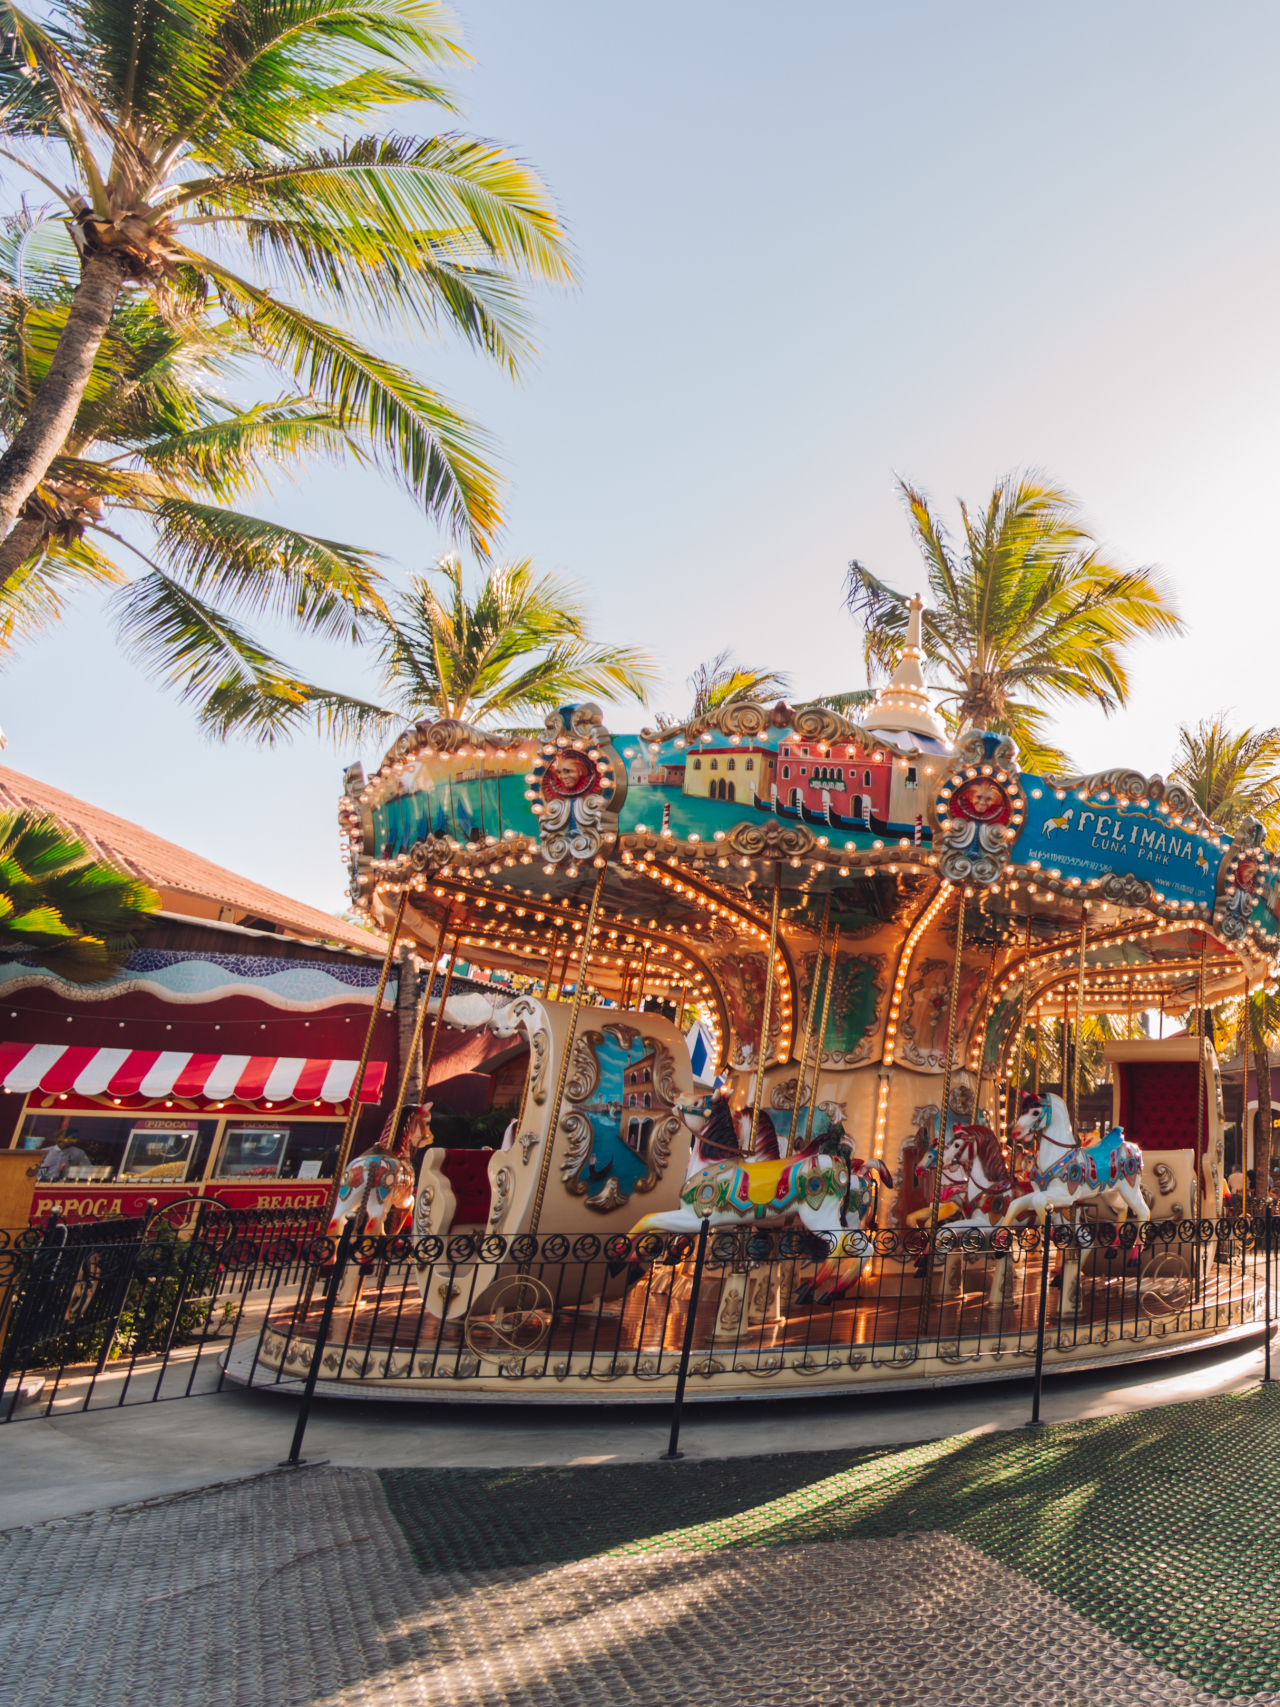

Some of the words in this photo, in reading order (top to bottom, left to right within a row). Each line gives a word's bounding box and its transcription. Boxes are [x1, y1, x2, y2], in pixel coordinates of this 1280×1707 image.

[1077, 810, 1192, 860] FELIMANA
[1091, 836, 1127, 855] LUNA
[1137, 848, 1171, 866] PARK
[148, 1120, 188, 1129] PIPOCA
[256, 1195, 321, 1210] BEACH
